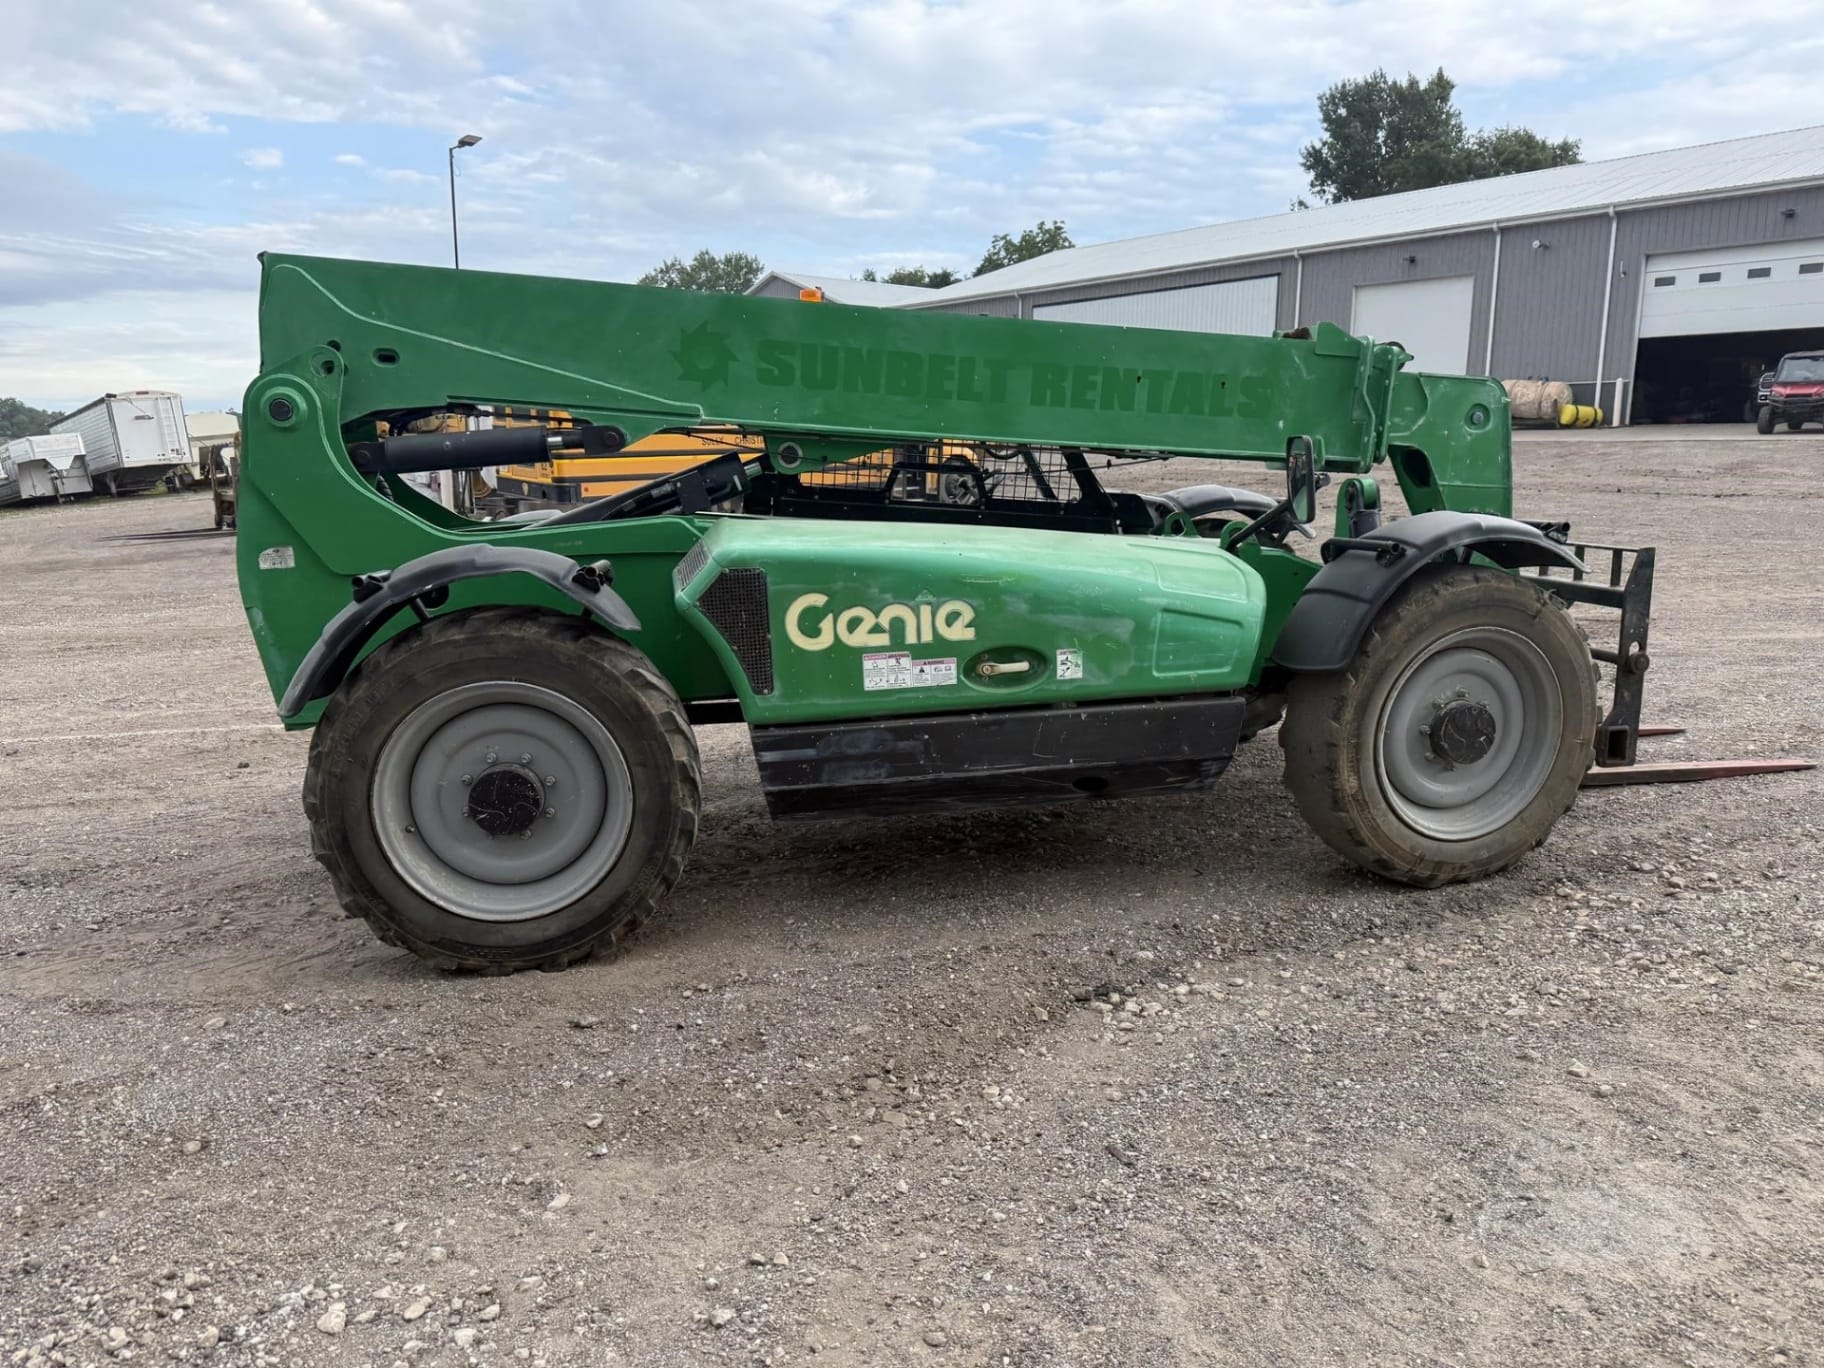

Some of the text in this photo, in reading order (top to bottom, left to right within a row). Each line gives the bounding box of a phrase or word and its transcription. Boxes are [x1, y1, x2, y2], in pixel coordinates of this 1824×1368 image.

[756, 339, 1273, 418] SUNBELT RENTALS
[785, 593, 976, 651] Genie
